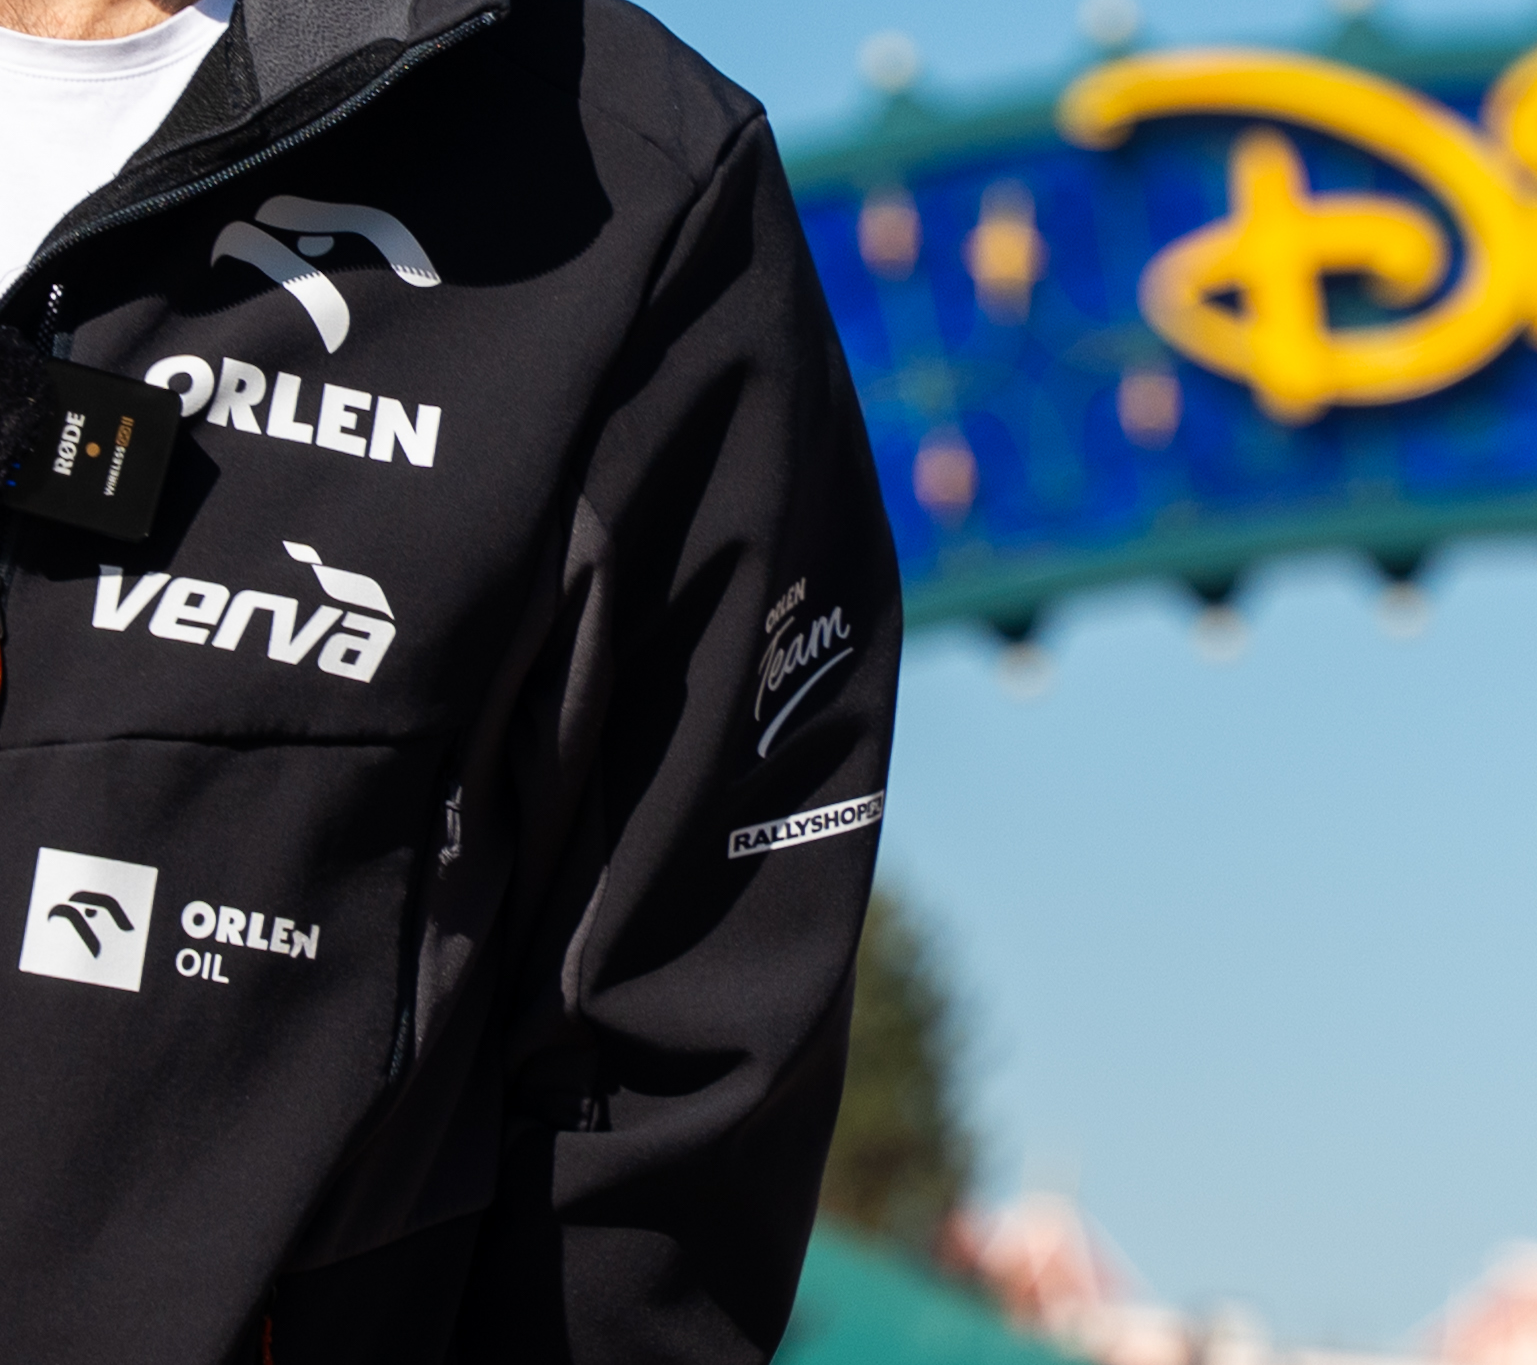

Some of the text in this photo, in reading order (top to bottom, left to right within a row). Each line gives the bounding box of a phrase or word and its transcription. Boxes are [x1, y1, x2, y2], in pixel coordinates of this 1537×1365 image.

[53, 410, 85, 476] RØDE
[144, 353, 442, 468] ORLEN
[92, 562, 397, 684] verva
[754, 606, 851, 722] Team
[175, 947, 229, 984] OIL
[181, 901, 320, 960] ORLEN
